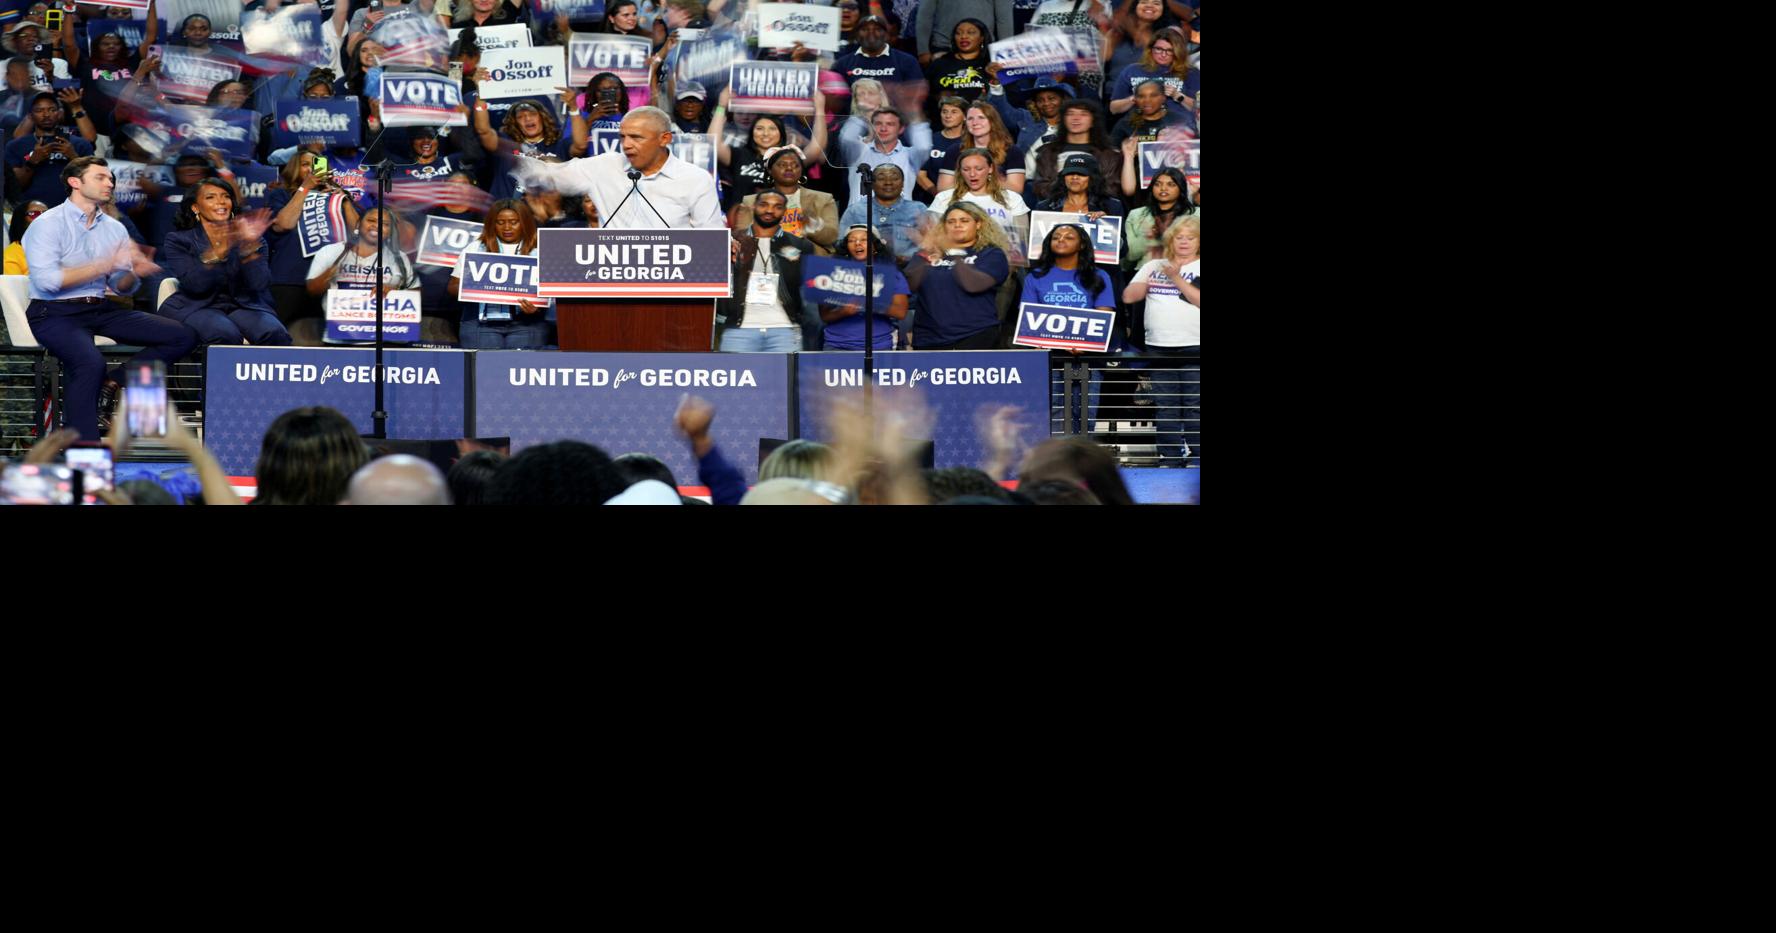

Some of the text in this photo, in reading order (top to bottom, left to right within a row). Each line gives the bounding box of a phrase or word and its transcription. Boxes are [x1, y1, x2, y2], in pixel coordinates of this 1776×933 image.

[773, 20, 829, 34] Ossoff
[504, 60, 532, 70] Jon
[574, 43, 646, 69] VOTE
[490, 66, 554, 82] Ossoff
[740, 68, 810, 86] UNITED
[852, 68, 896, 76] Ossoff
[386, 79, 459, 106] VOTE
[747, 83, 809, 98] GEORGIA
[1144, 148, 1200, 169] VOT
[432, 225, 486, 249] VOT
[575, 244, 692, 265] UNITED
[585, 267, 685, 280] for GEORGIA
[1043, 293, 1087, 304] GEORGIA
[1149, 287, 1180, 296] GOVERNO
[1026, 311, 1107, 337] VOTE
[236, 363, 317, 382] UNITED
[320, 367, 341, 385] for
[509, 368, 757, 390] UNITED for GEORGIA
[824, 367, 1022, 388] UNIED for GEORGIA
